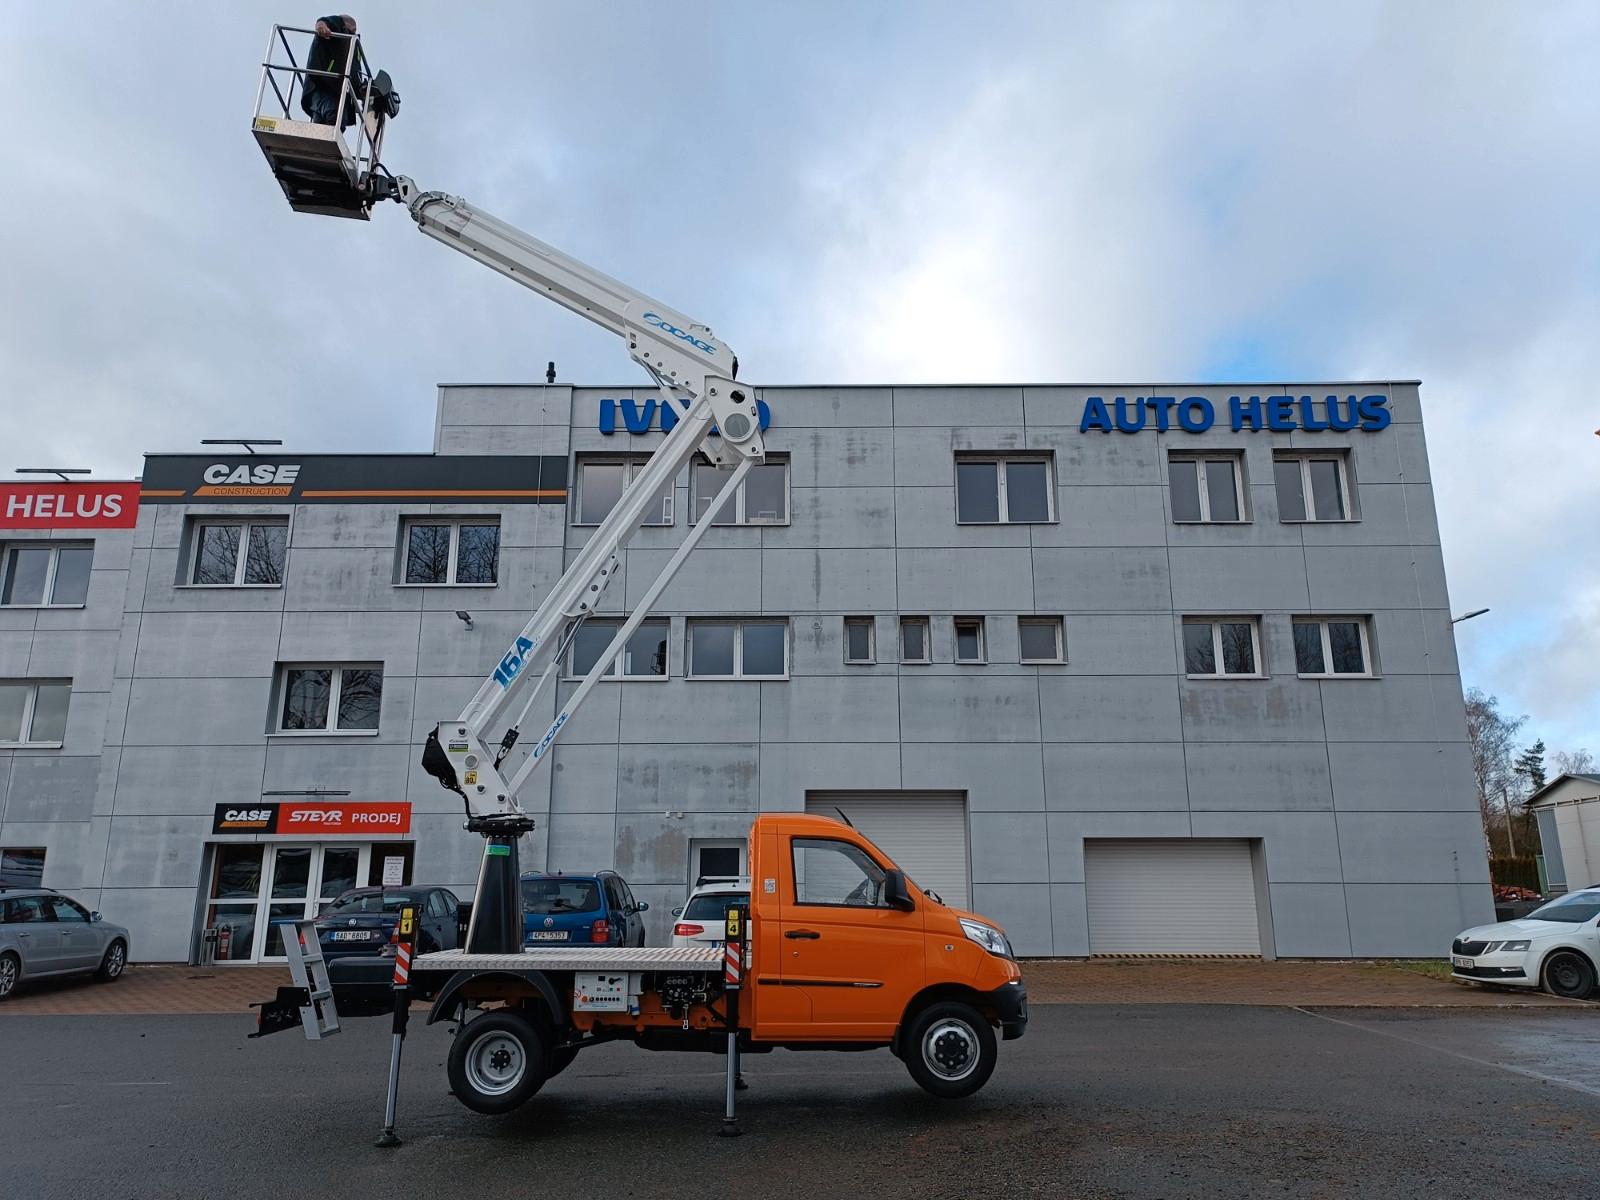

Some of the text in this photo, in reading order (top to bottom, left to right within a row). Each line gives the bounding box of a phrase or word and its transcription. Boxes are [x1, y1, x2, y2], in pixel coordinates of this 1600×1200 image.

[1079, 395, 1391, 433] AUTO HELUS
[203, 463, 301, 484] CASE
[213, 487, 288, 495] CONSTRUCTION
[6, 493, 122, 518] HELUS
[493, 635, 534, 689] 16A
[225, 809, 272, 821] CASE
[288, 810, 343, 822] STEYR
[351, 812, 402, 825] PRODEJ
